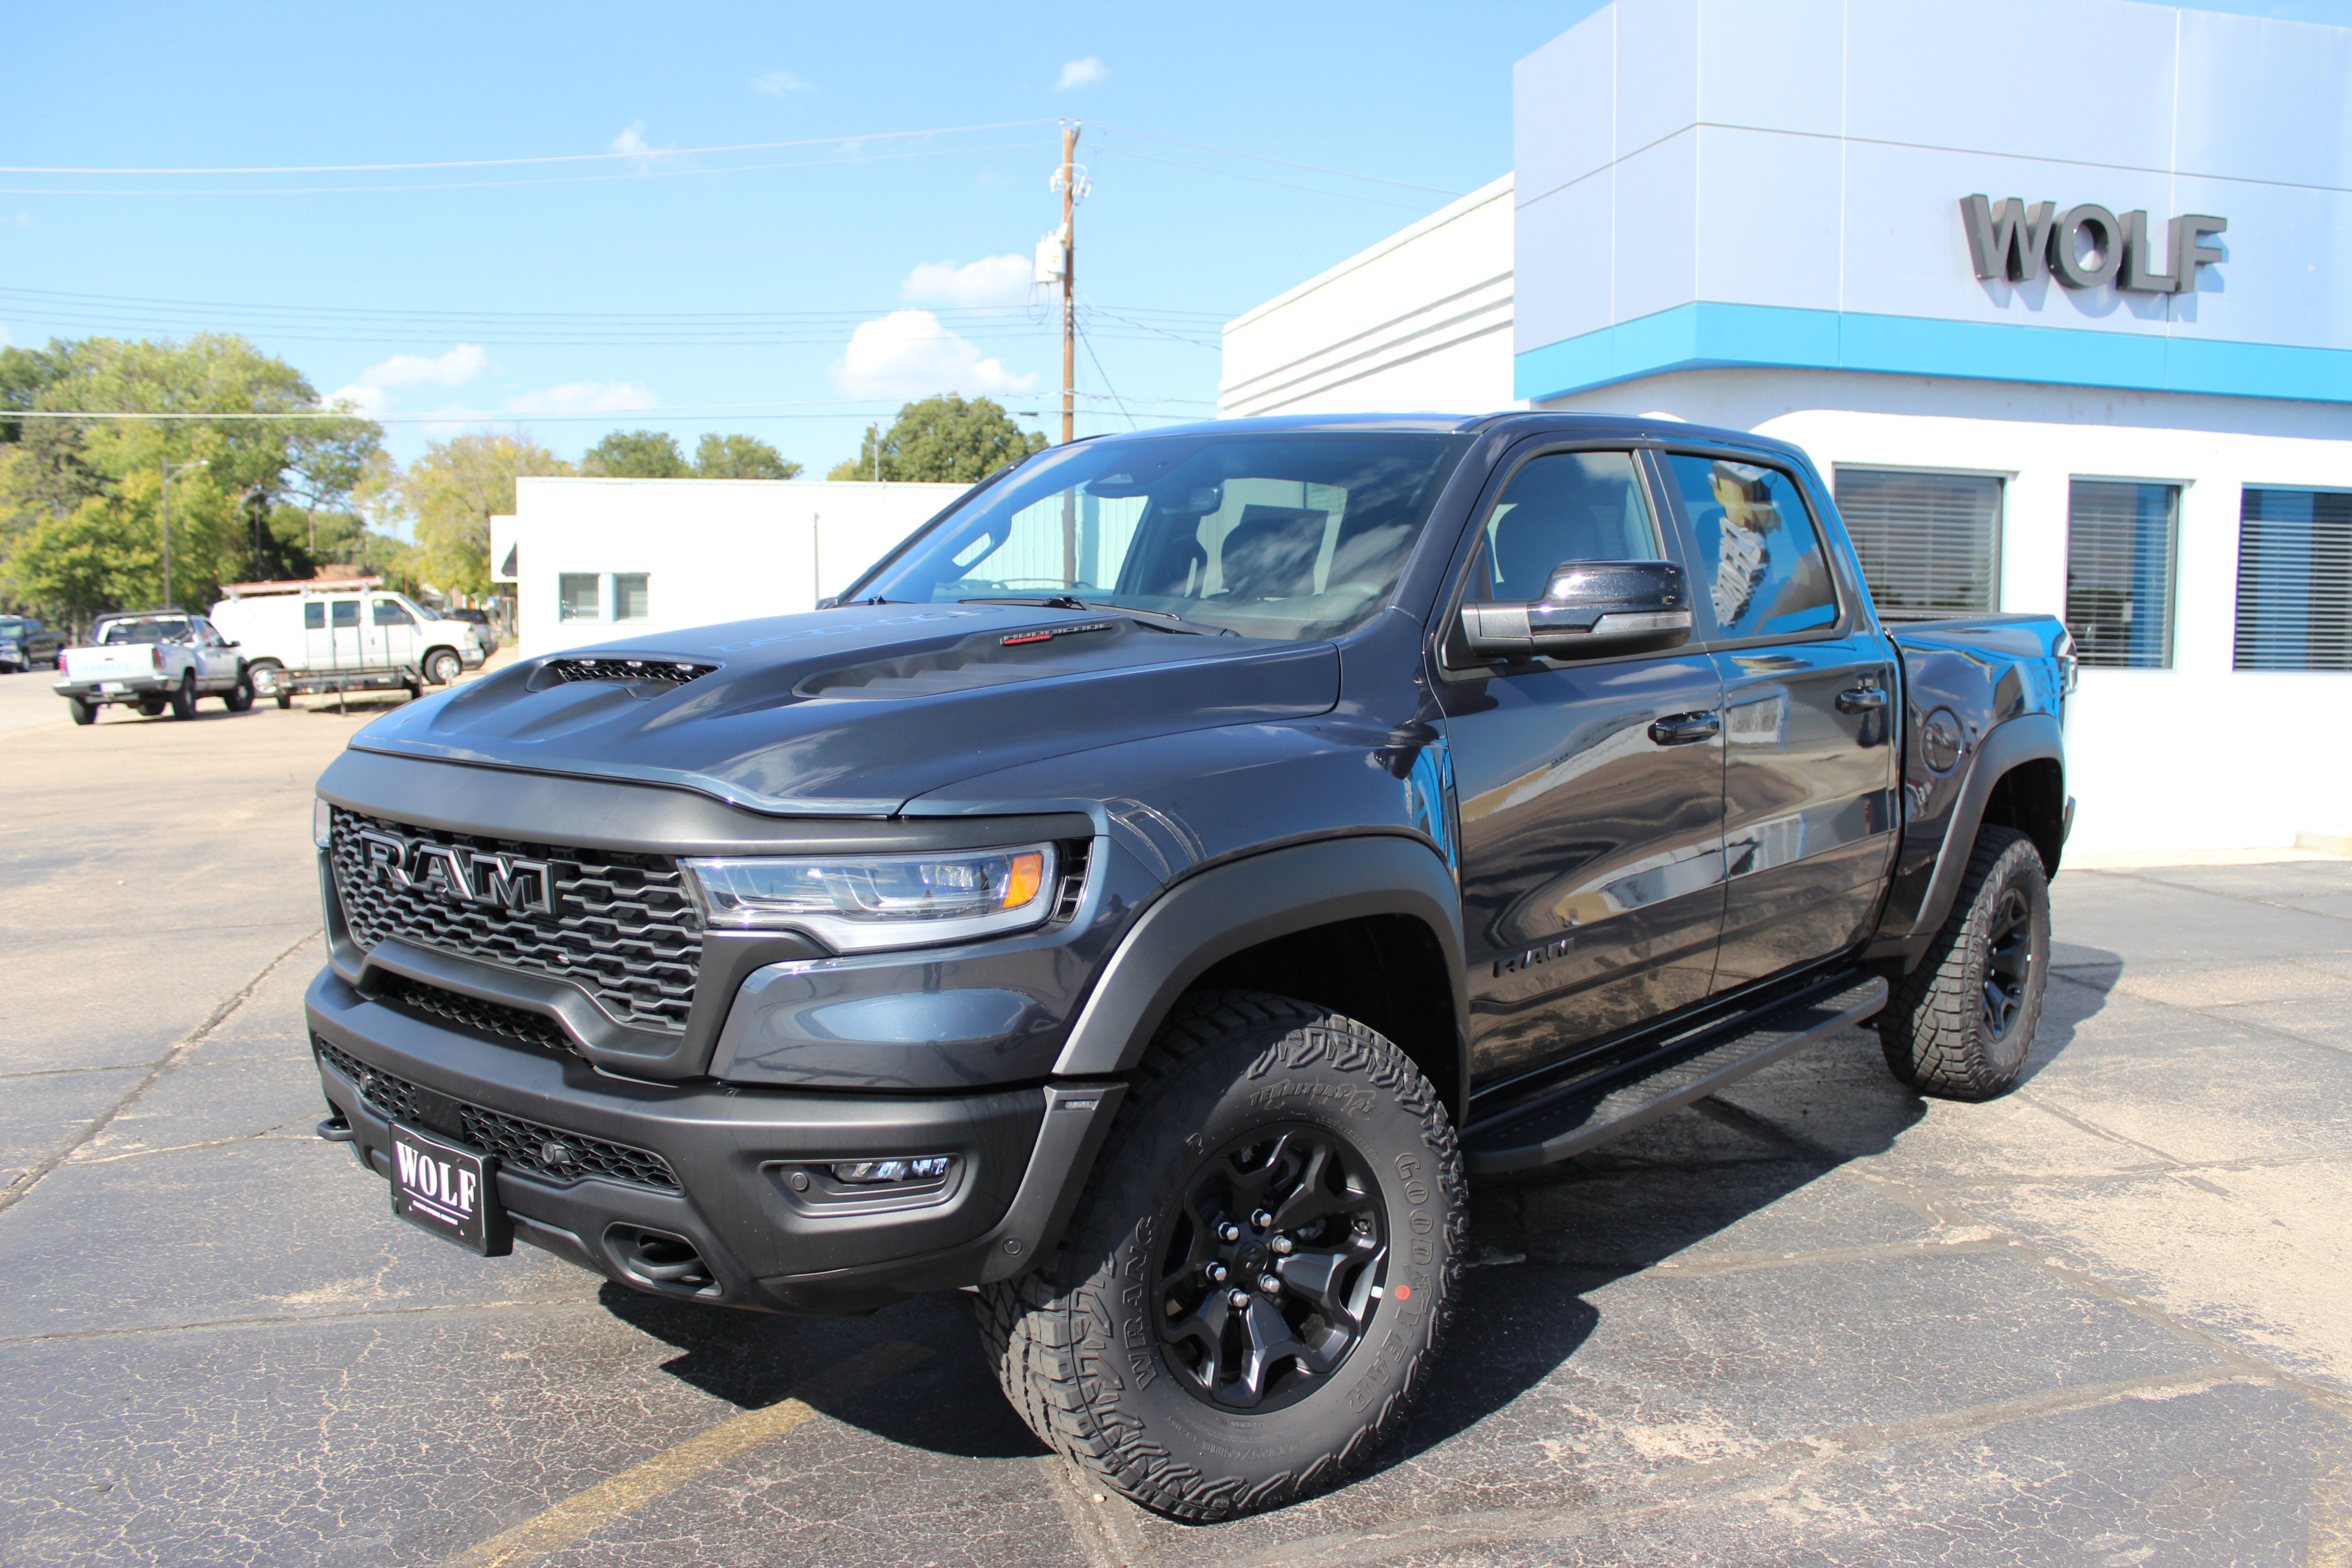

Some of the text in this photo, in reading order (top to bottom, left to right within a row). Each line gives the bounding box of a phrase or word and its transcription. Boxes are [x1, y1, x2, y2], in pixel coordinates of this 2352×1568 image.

[1959, 193, 2227, 294] WOLF
[360, 829, 556, 914] RAM
[1493, 937, 1574, 978] RAM
[1250, 1083, 1348, 1106] TERRITORY
[1352, 1098, 1376, 1113] AT
[395, 1141, 476, 1212] WOLF
